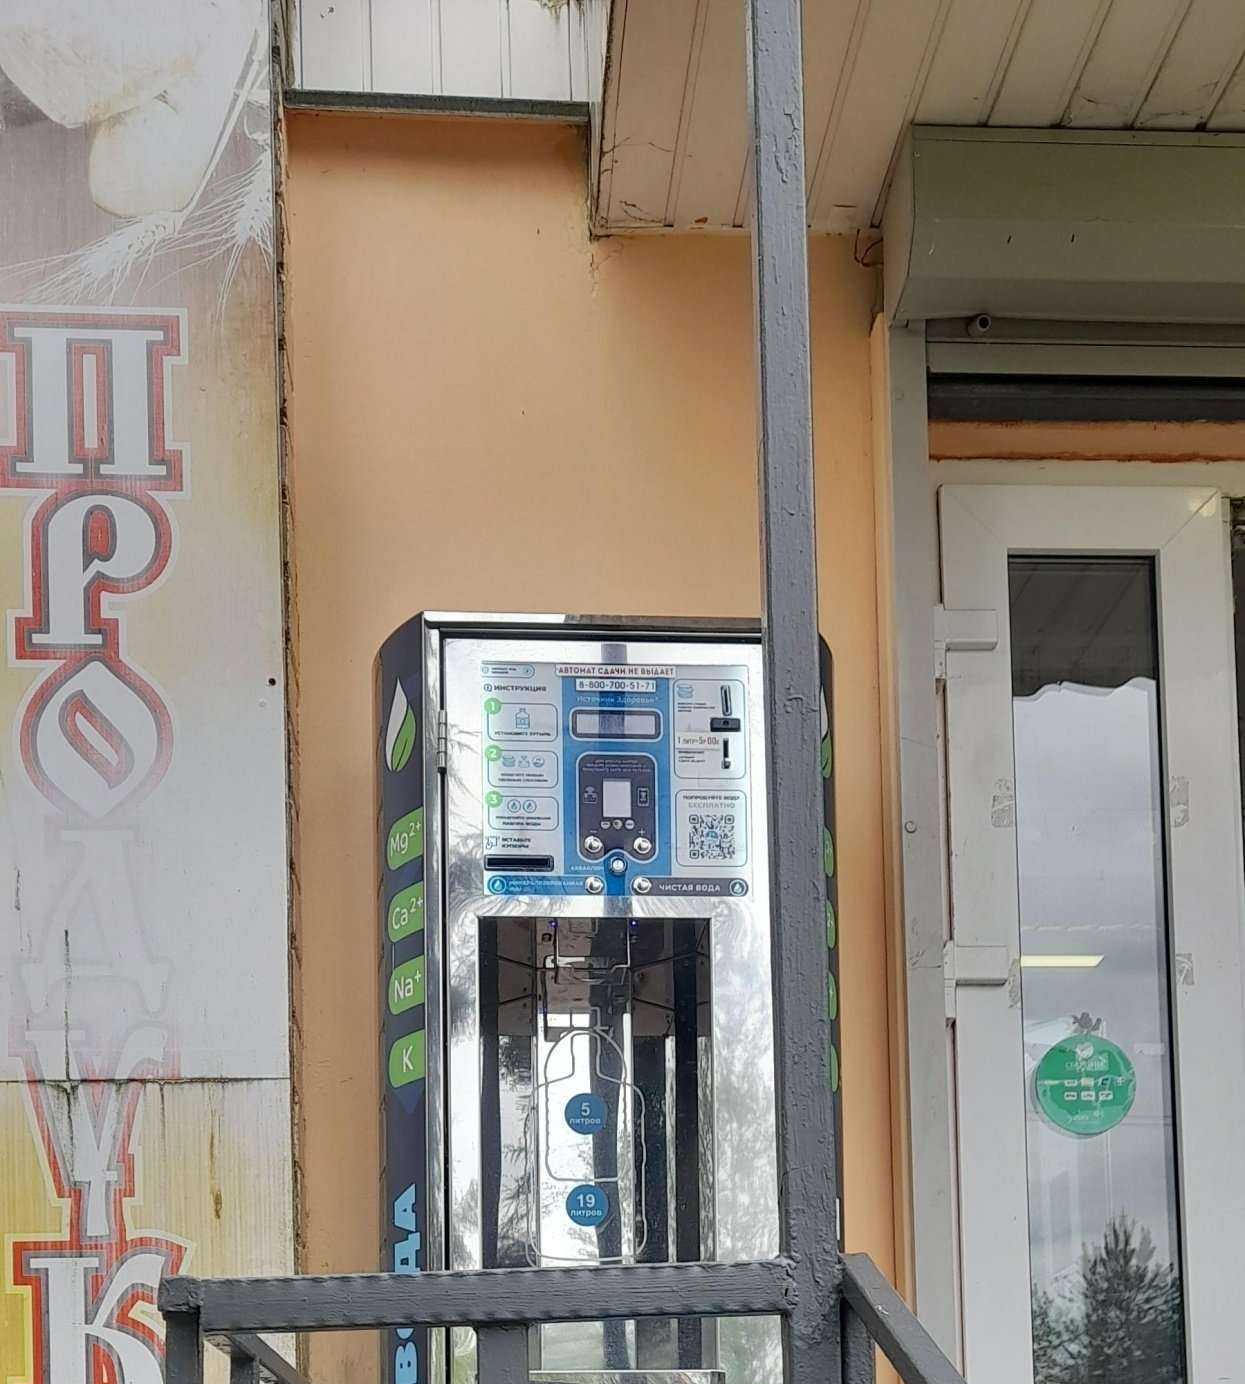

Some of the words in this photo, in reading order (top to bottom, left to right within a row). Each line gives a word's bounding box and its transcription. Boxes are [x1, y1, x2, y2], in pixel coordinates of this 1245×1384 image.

[558, 666, 595, 674] АВТОМАТ
[598, 667, 626, 675] СДАЧИ
[641, 667, 674, 675] ВЫДАЕТ
[493, 684, 547, 692] ИНСТРУКЦИЯ
[579, 680, 655, 690] 8-800-700-51-71
[394, 969, 422, 1003] Na+
[402, 1045, 414, 1073] K
[580, 1102, 591, 1116] 5
[569, 1117, 601, 1125] литров
[576, 1193, 596, 1208] 19
[570, 1209, 602, 1217] литров
